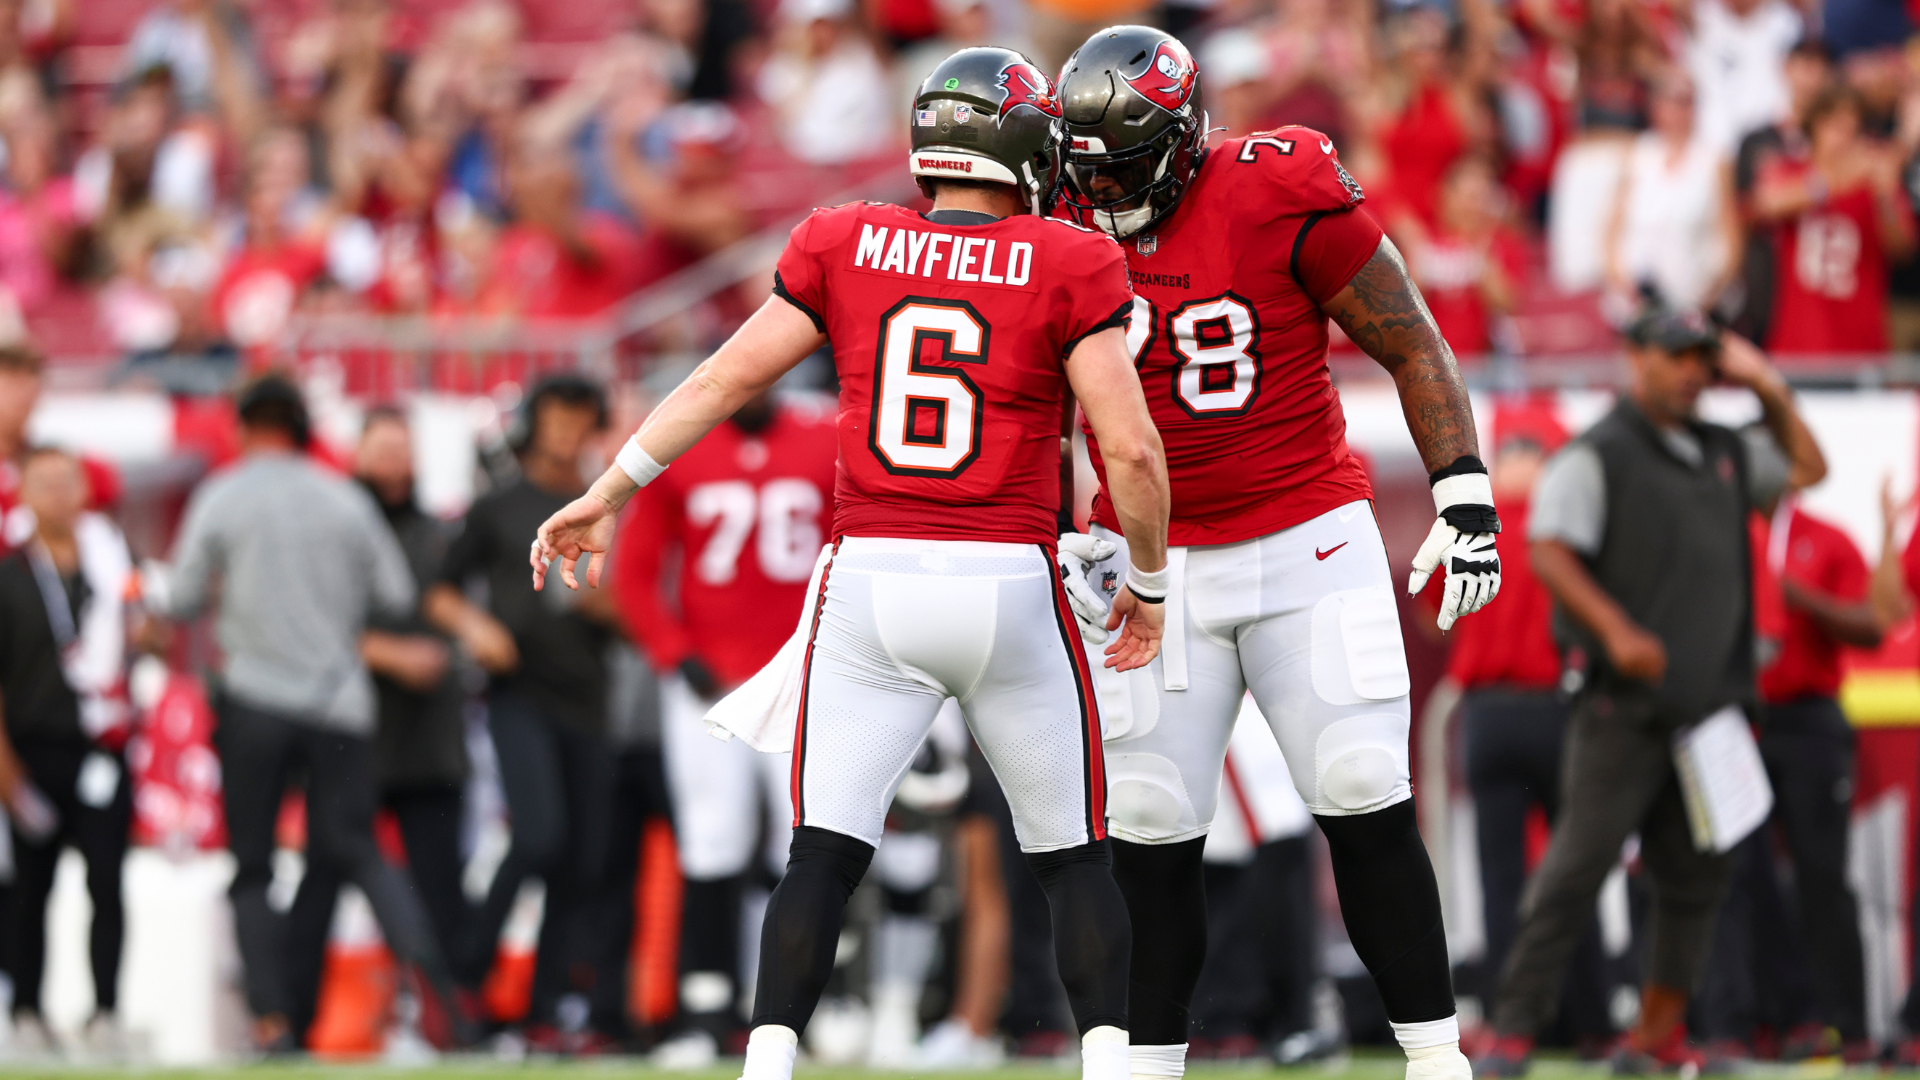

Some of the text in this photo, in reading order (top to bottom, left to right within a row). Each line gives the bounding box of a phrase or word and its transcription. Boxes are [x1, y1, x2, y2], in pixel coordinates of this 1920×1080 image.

[918, 158, 972, 173] BUCCANEERS
[1236, 125, 1302, 163] 7
[854, 223, 1034, 287] MAYFIELD
[1128, 269, 1190, 289] CCANEERS
[868, 295, 992, 480] 6
[687, 477, 823, 584] 76
